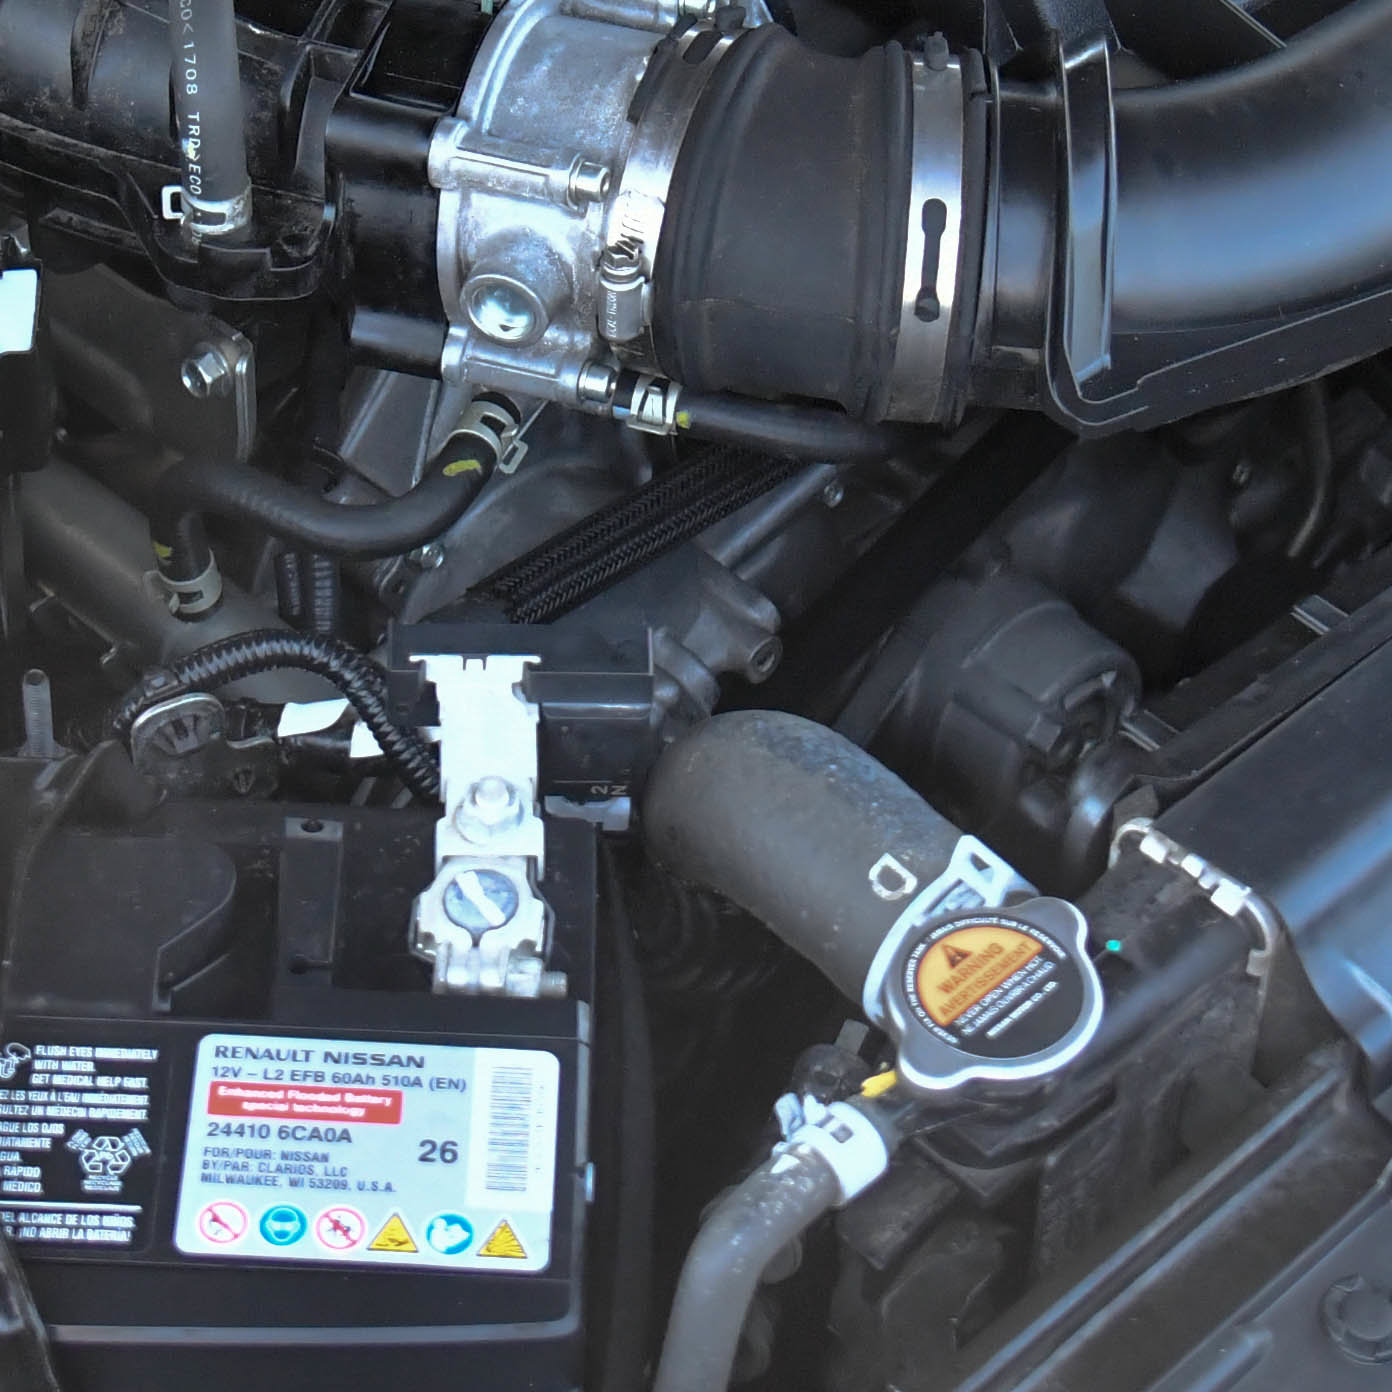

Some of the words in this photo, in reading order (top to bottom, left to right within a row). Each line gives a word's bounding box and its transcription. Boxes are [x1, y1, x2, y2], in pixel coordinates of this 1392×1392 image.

[937, 943, 1004, 993] WARNING
[939, 941, 1033, 1015] AVERTISSEMENT
[979, 987, 1003, 1007] OPEN
[1000, 969, 1026, 990] WHEN
[35, 1045, 67, 1057] FLUSH
[69, 1046, 93, 1058] EYES
[214, 1045, 315, 1064] RENAULT
[324, 1050, 425, 1069] NISSAN
[33, 1060, 59, 1070] WITH
[32, 1074, 50, 1085] GET
[52, 1075, 94, 1086] MEDICAL
[96, 1076, 121, 1087] HELP
[212, 1066, 242, 1079] 12V
[263, 1068, 283, 1080] L2
[291, 1070, 325, 1083] EFB
[331, 1072, 375, 1086] 60Ah
[382, 1075, 423, 1088] 510A
[429, 1076, 467, 1092] (EN)
[218, 1085, 283, 1100] Enhanced
[287, 1089, 341, 1102] Flooded
[344, 1091, 392, 1107] Battery
[242, 1101, 289, 1113] special
[293, 1103, 366, 1118] technology
[22, 1122, 39, 1133] LOS
[207, 1122, 271, 1140] 24410
[278, 1124, 352, 1144] 6CA0A
[203, 1147, 272, 1160] FOR/POUR:
[280, 1151, 330, 1163] NISSAN
[417, 1139, 459, 1164] 26
[324, 1166, 348, 1178] LLC
[289, 1177, 305, 1188] WI
[18, 1213, 62, 1225] ALCANCE
[65, 1214, 80, 1225] DE
[82, 1215, 101, 1226] LOS
[39, 1228, 69, 1239] ABRIR
[71, 1229, 84, 1240] LA
